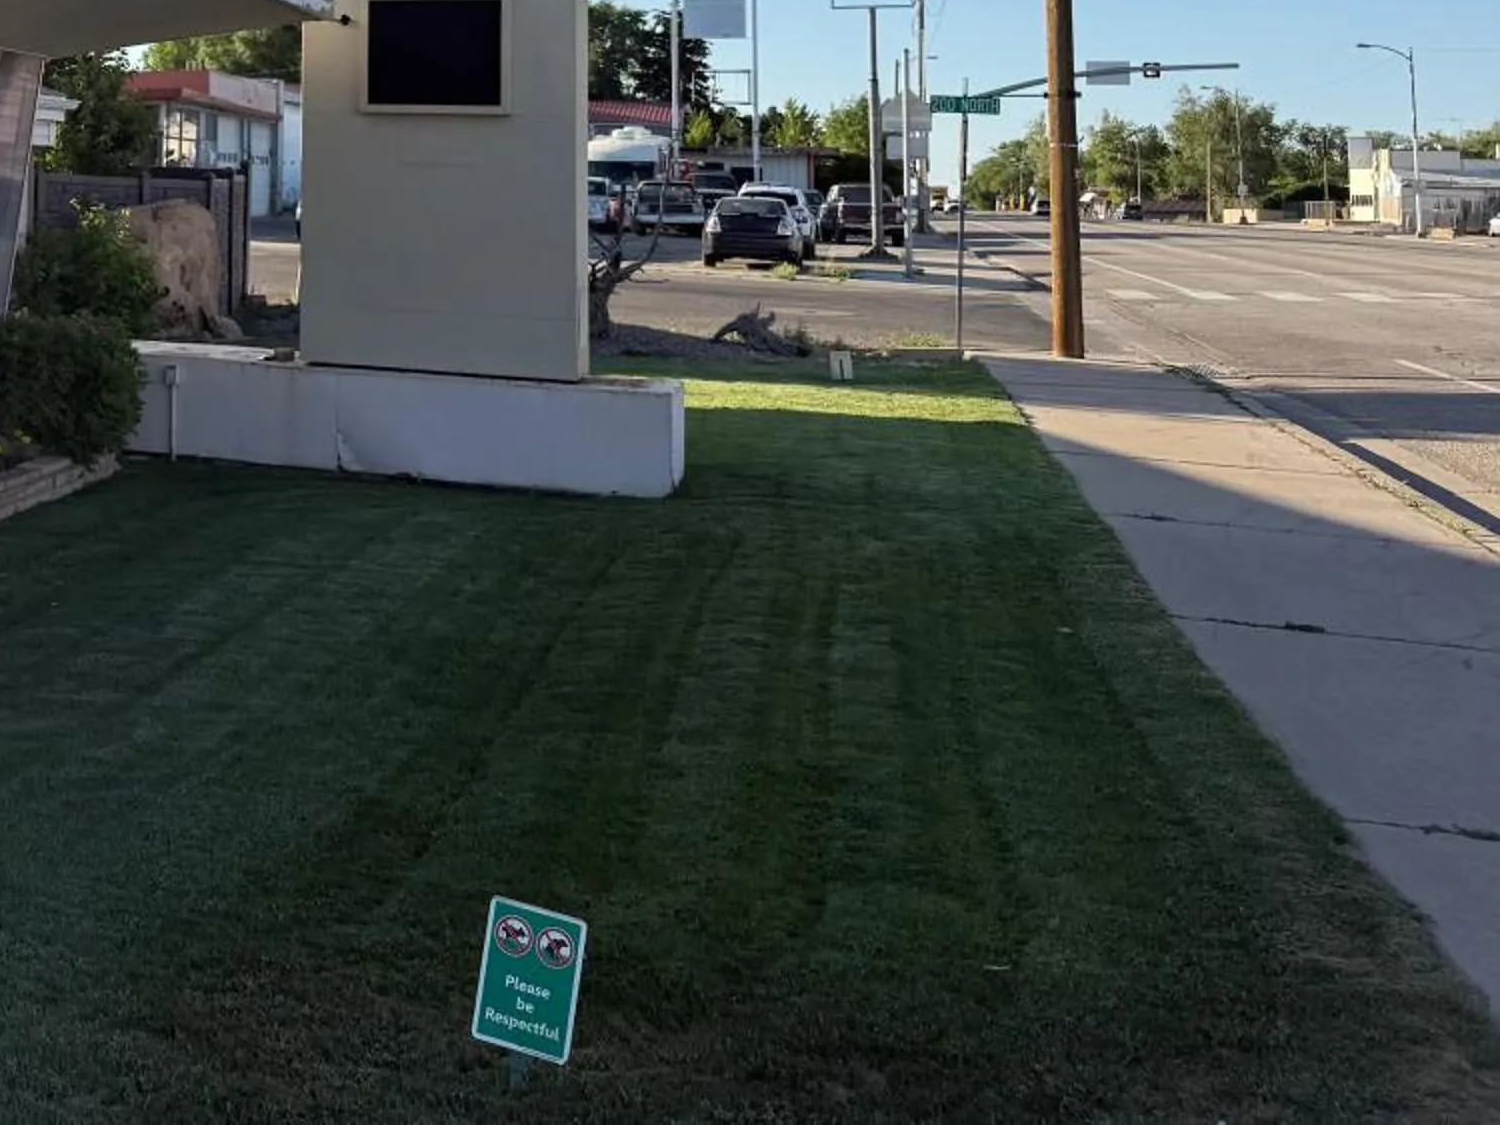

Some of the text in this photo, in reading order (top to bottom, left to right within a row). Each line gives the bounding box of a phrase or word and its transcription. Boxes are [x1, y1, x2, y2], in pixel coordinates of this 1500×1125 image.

[505, 976, 550, 999] Please
[516, 997, 534, 1013] be
[485, 1007, 560, 1041] Respectful
